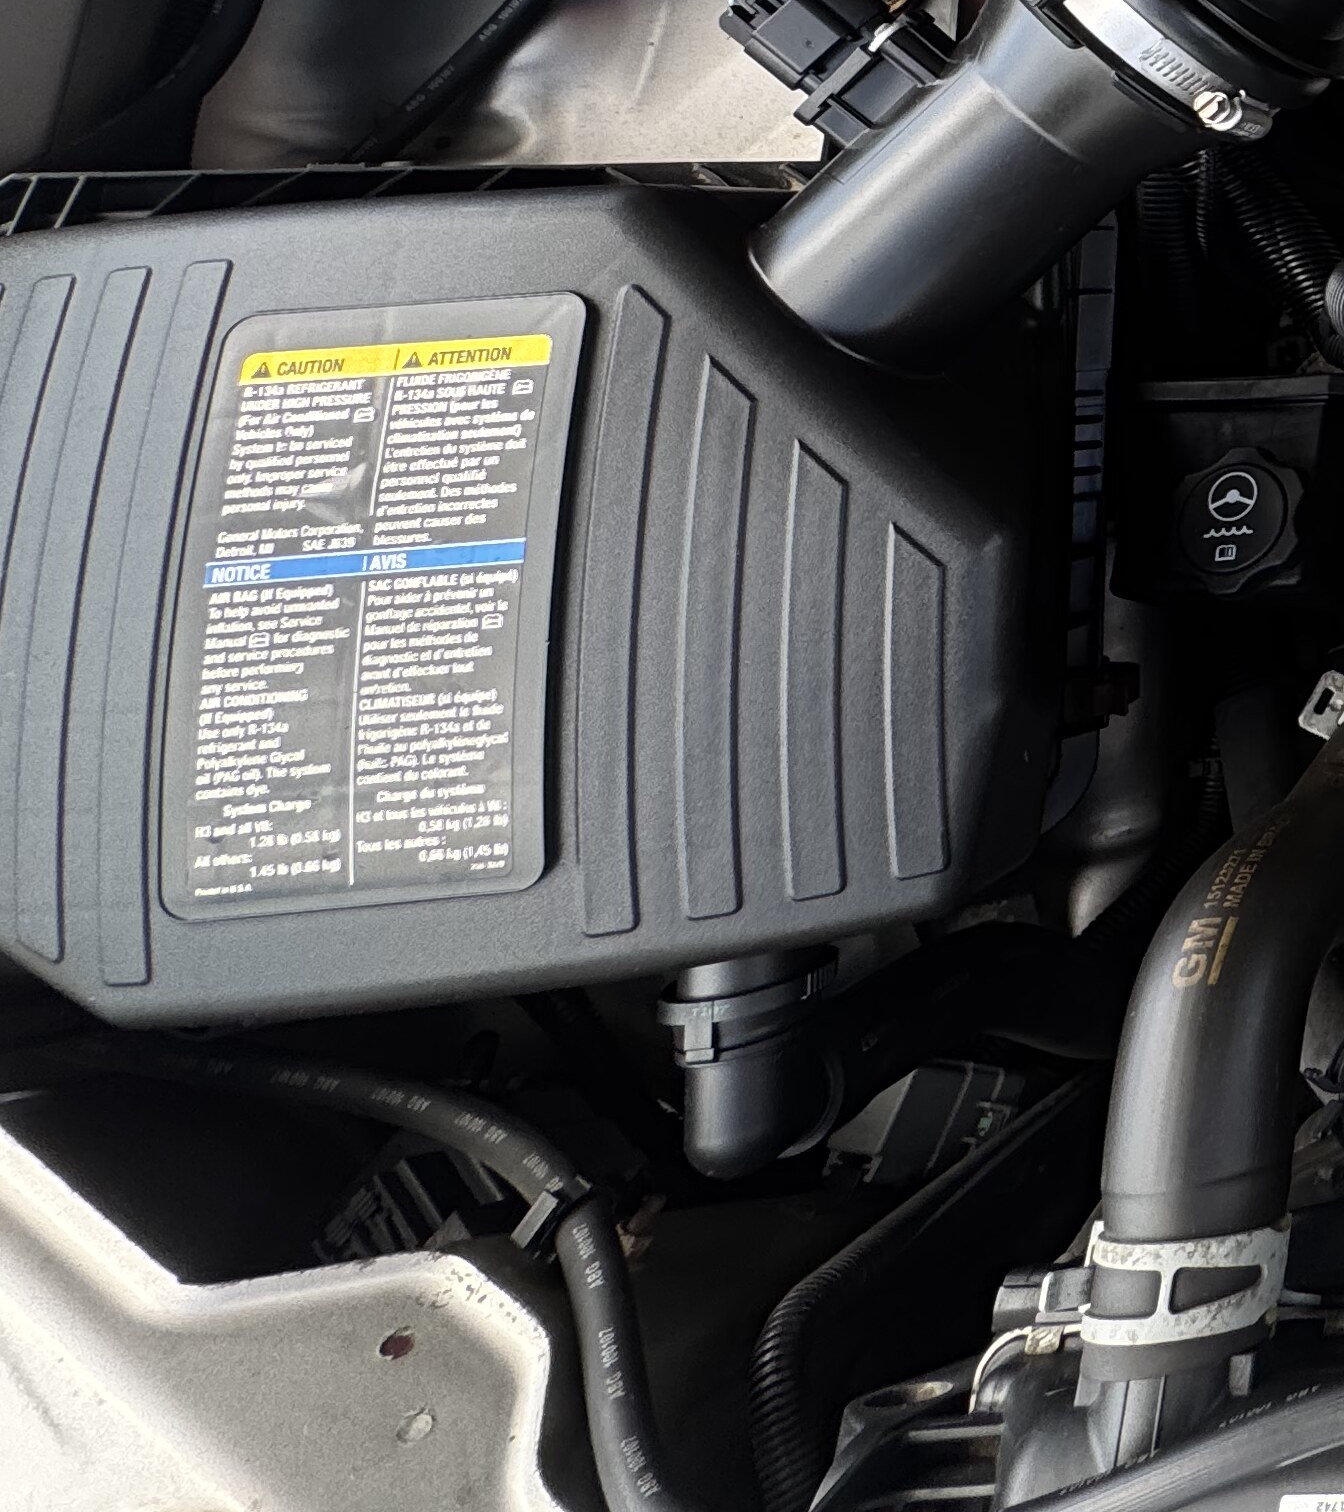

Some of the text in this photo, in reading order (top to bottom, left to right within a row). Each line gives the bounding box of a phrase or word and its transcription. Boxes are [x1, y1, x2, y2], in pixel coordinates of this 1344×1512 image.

[427, 346, 512, 366] ATTENTION
[276, 357, 345, 376] CAUTION
[369, 553, 407, 570] AVIS
[211, 563, 271, 583] NOTICE
[1225, 845, 1265, 907] MADE IN
[1172, 916, 1220, 989] GM
